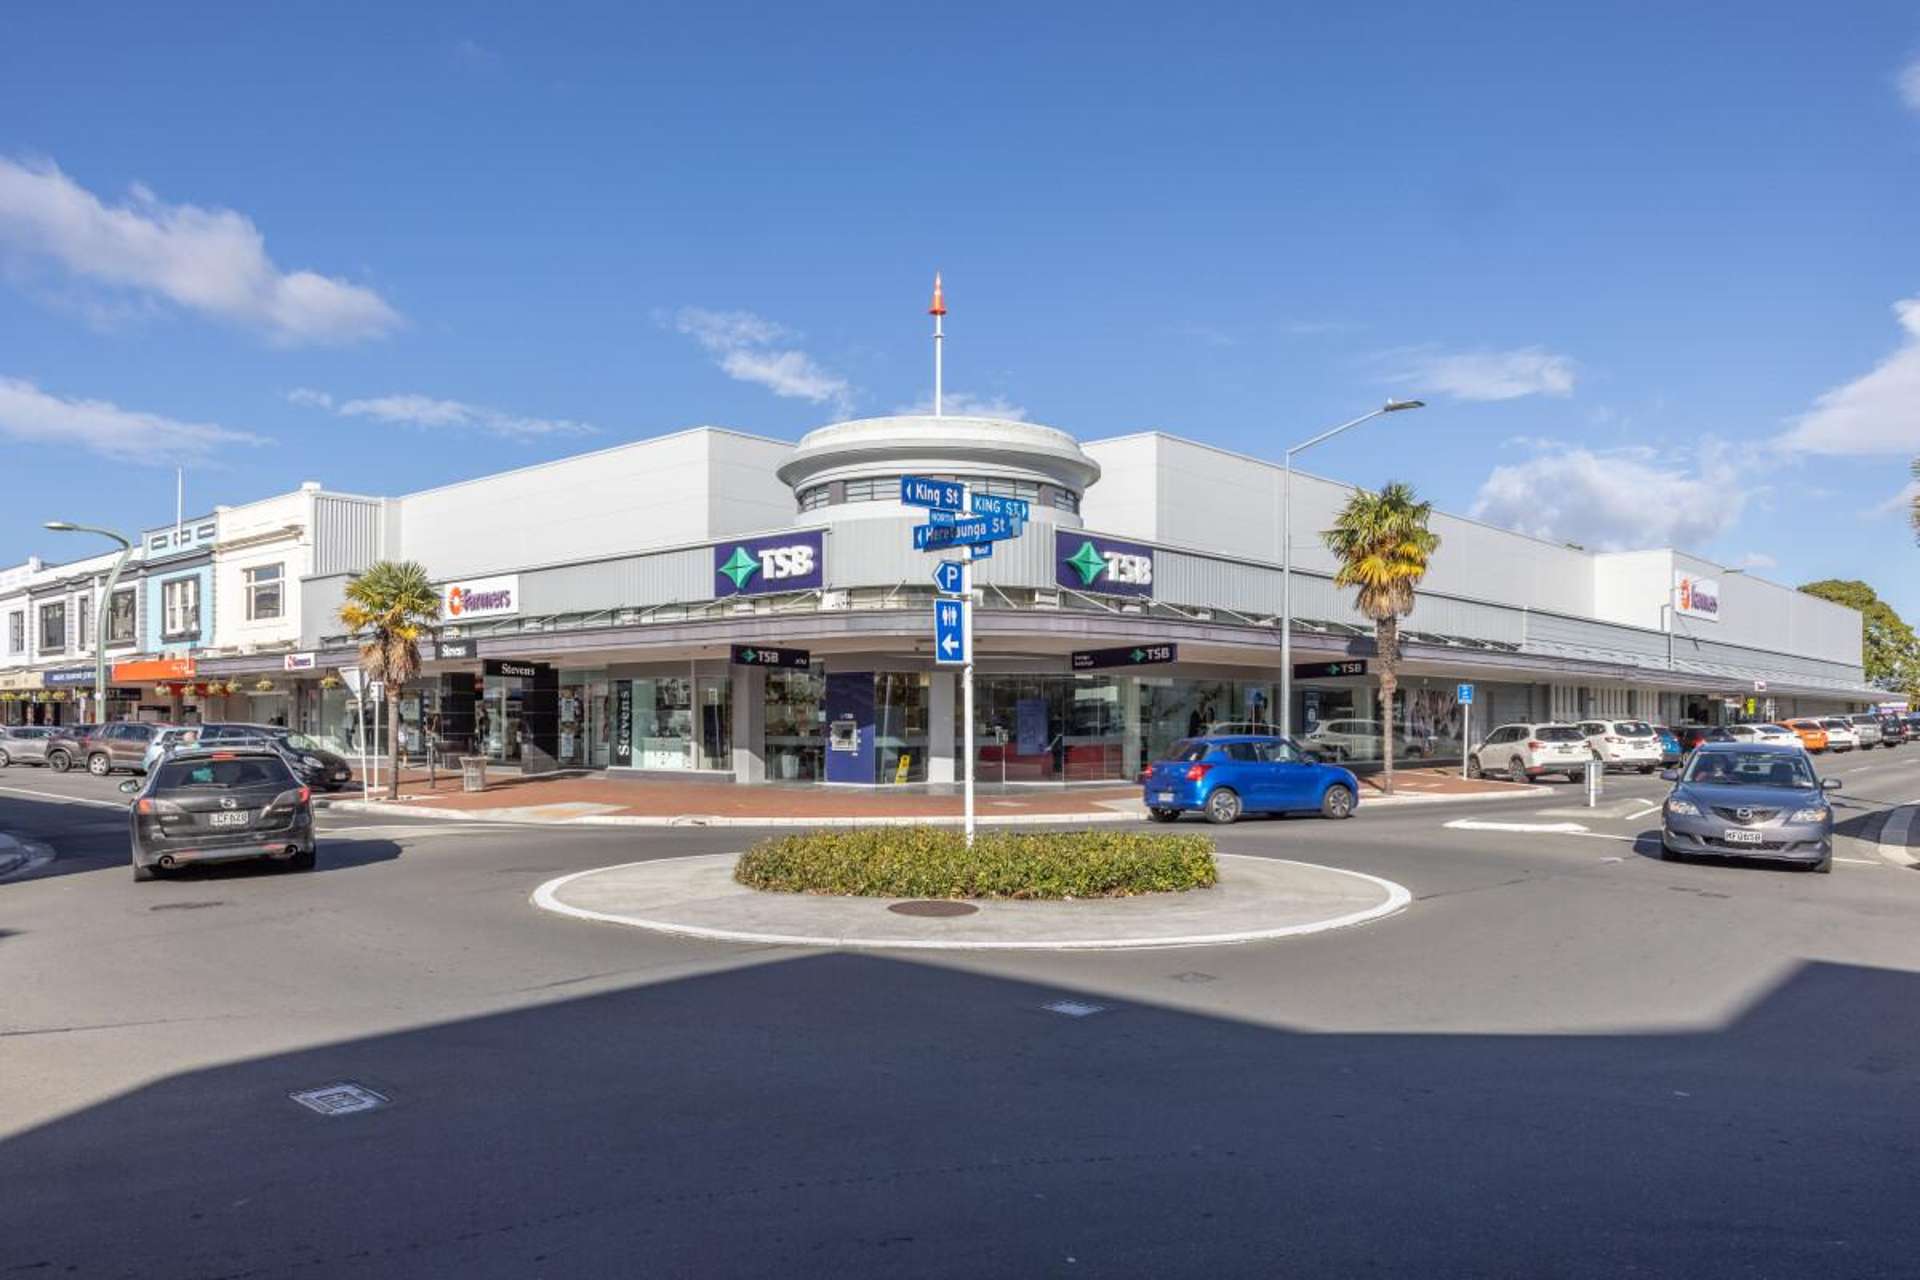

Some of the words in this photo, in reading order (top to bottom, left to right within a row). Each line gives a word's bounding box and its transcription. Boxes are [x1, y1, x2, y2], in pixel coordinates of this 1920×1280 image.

[915, 483, 940, 506] King
[946, 487, 959, 504] St
[975, 498, 1001, 513] KING
[992, 517, 1006, 533] St
[758, 545, 814, 579] TSB
[1102, 551, 1152, 585] TSB
[946, 566, 957, 588] P
[463, 589, 511, 612] Farmers
[757, 650, 779, 663] TSB
[1146, 647, 1170, 660] TSB
[501, 663, 535, 676] Stevens
[1342, 664, 1362, 673] TSB
[618, 690, 631, 757] Stevens
